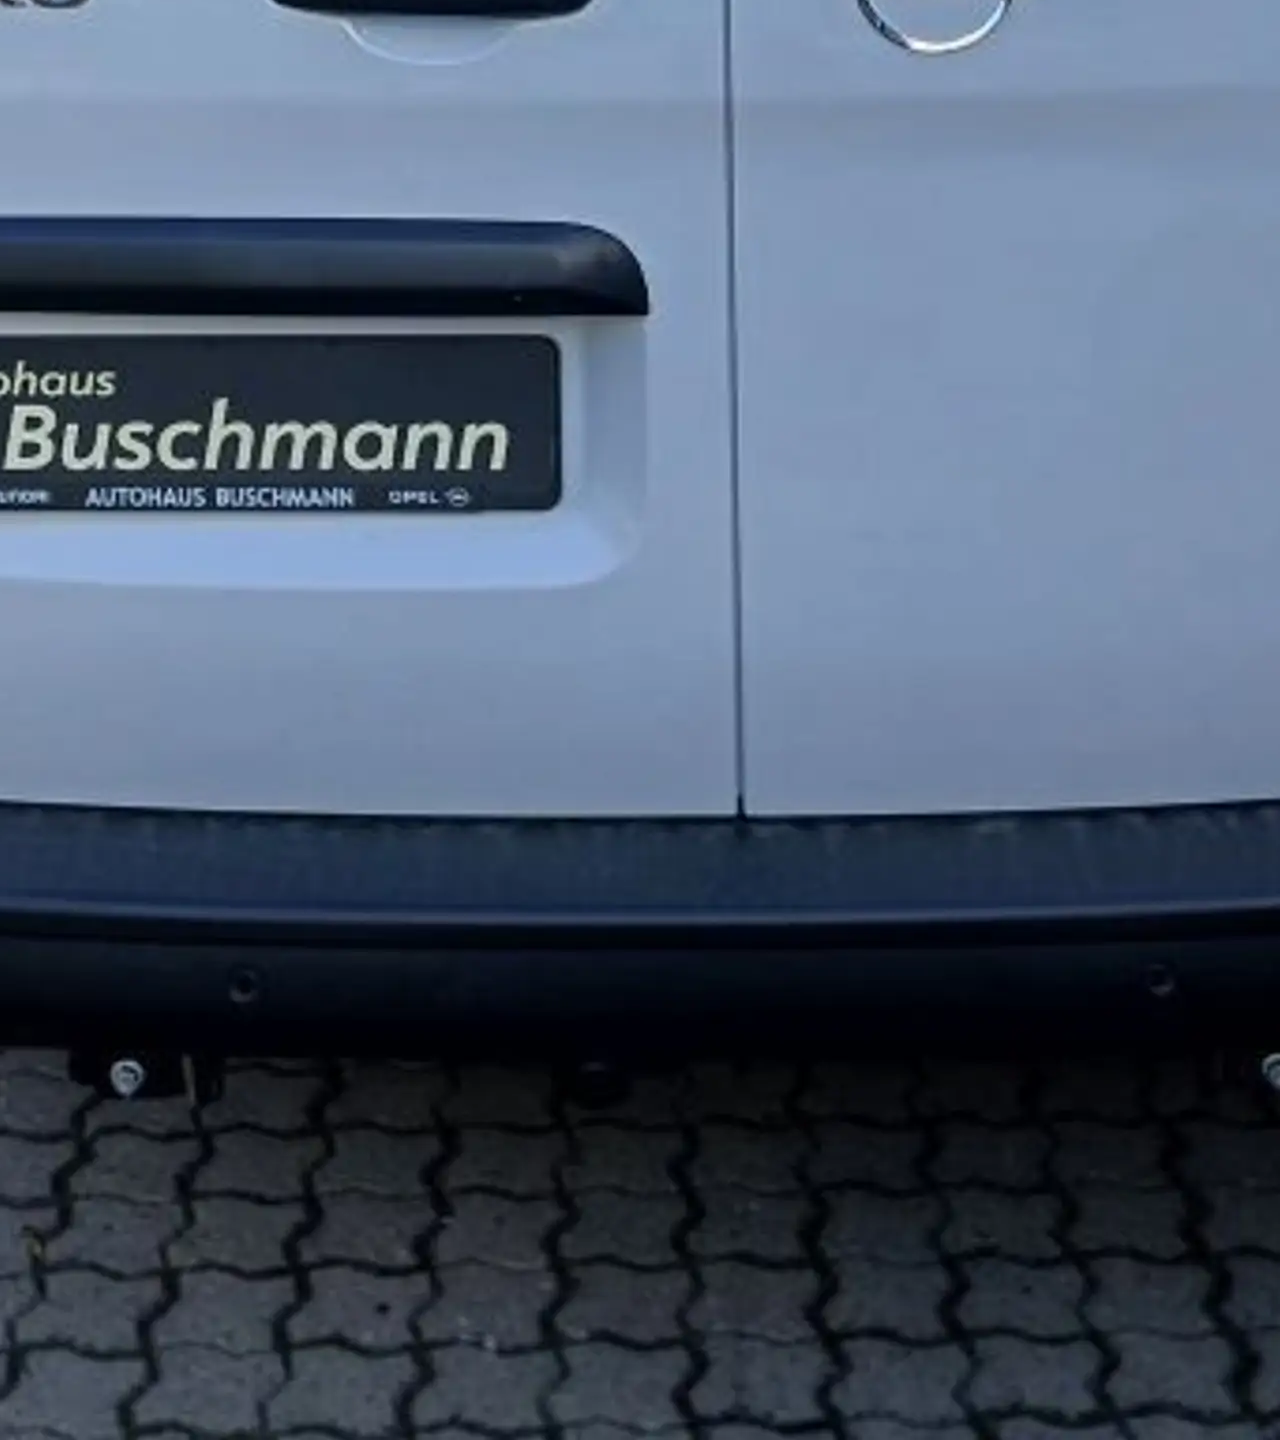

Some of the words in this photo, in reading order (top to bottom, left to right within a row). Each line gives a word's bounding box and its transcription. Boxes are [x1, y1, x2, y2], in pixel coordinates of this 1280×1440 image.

[3, 398, 509, 471] Buschmann
[85, 487, 206, 507] AUTOHAUS
[216, 487, 356, 507] BUSCHMANN
